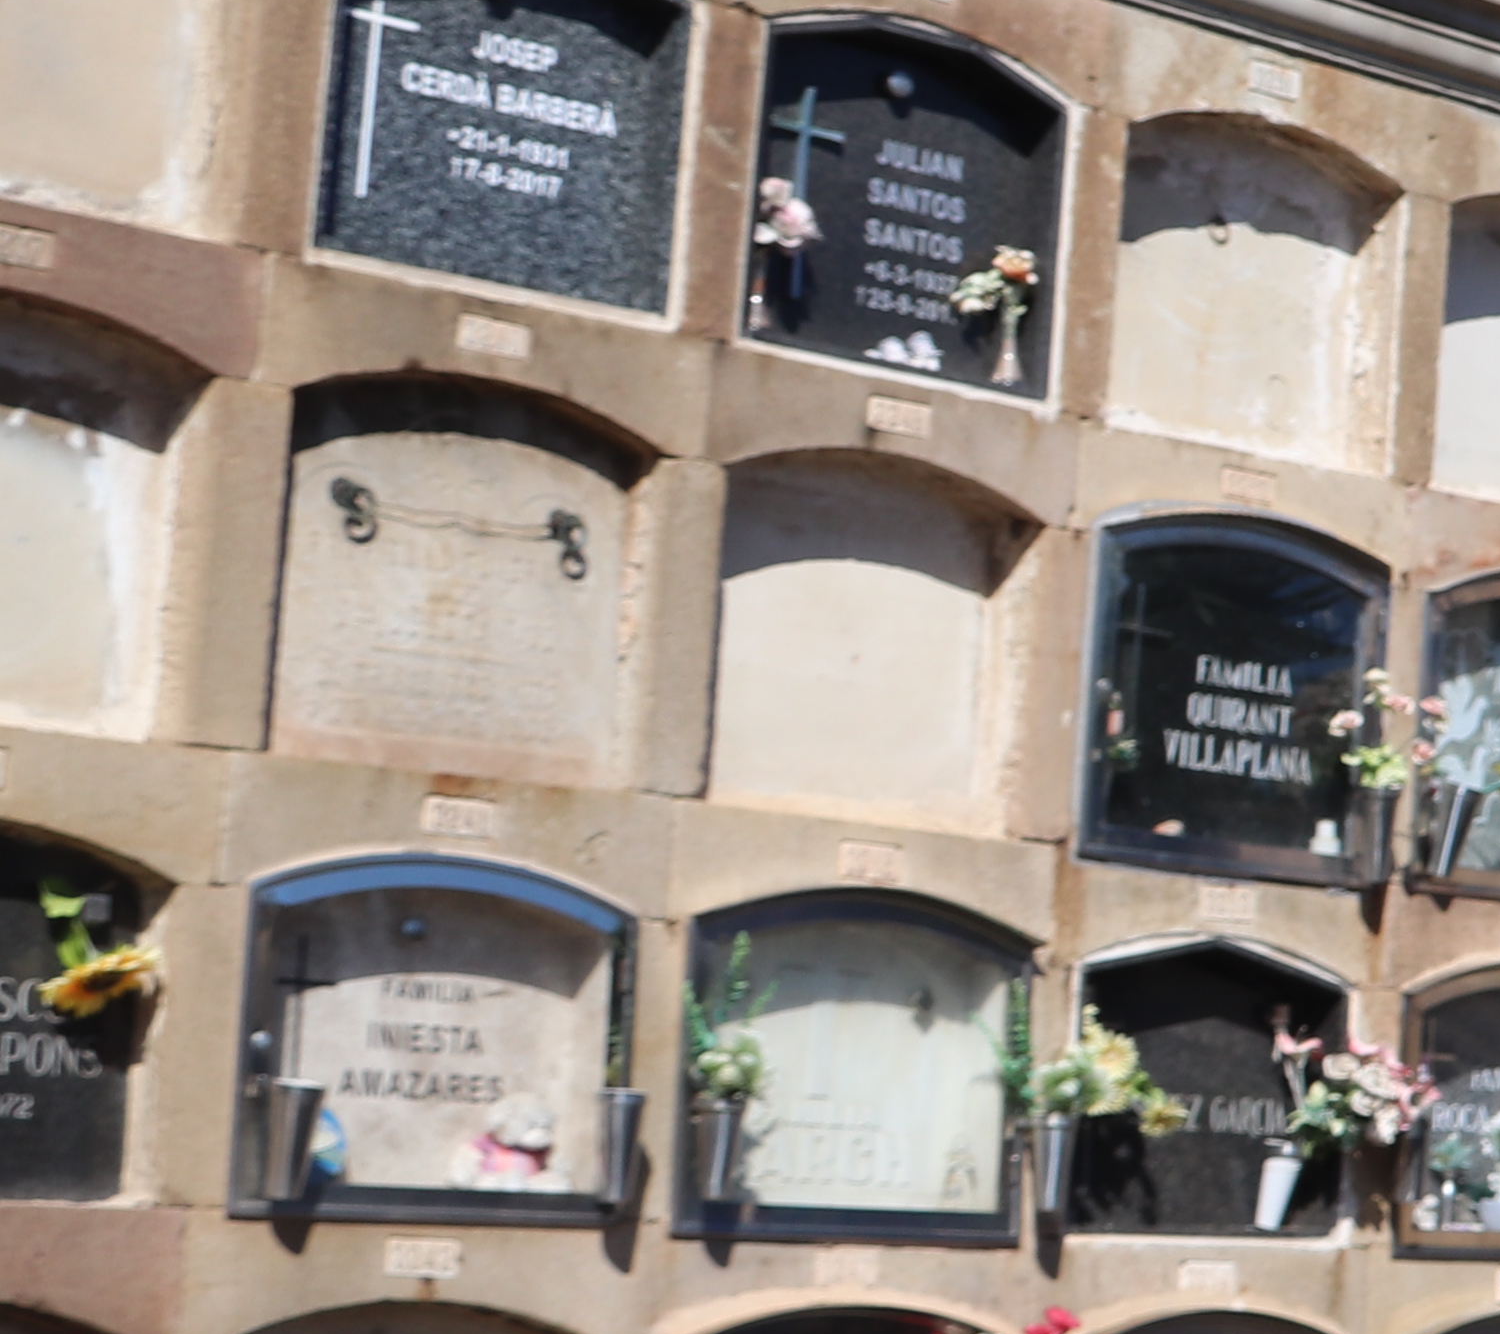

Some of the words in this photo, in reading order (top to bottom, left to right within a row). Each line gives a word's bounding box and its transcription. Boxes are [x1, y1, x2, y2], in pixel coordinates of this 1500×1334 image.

[470, 30, 558, 72] JOSEP
[874, 139, 965, 183] JULIAN
[866, 176, 966, 224] SANTOS
[863, 217, 964, 264] SANTOS
[1196, 655, 1293, 698] FAMILIA
[1165, 730, 1312, 785] VILLAPLANA
[1431, 1102, 1488, 1132] ROCA
